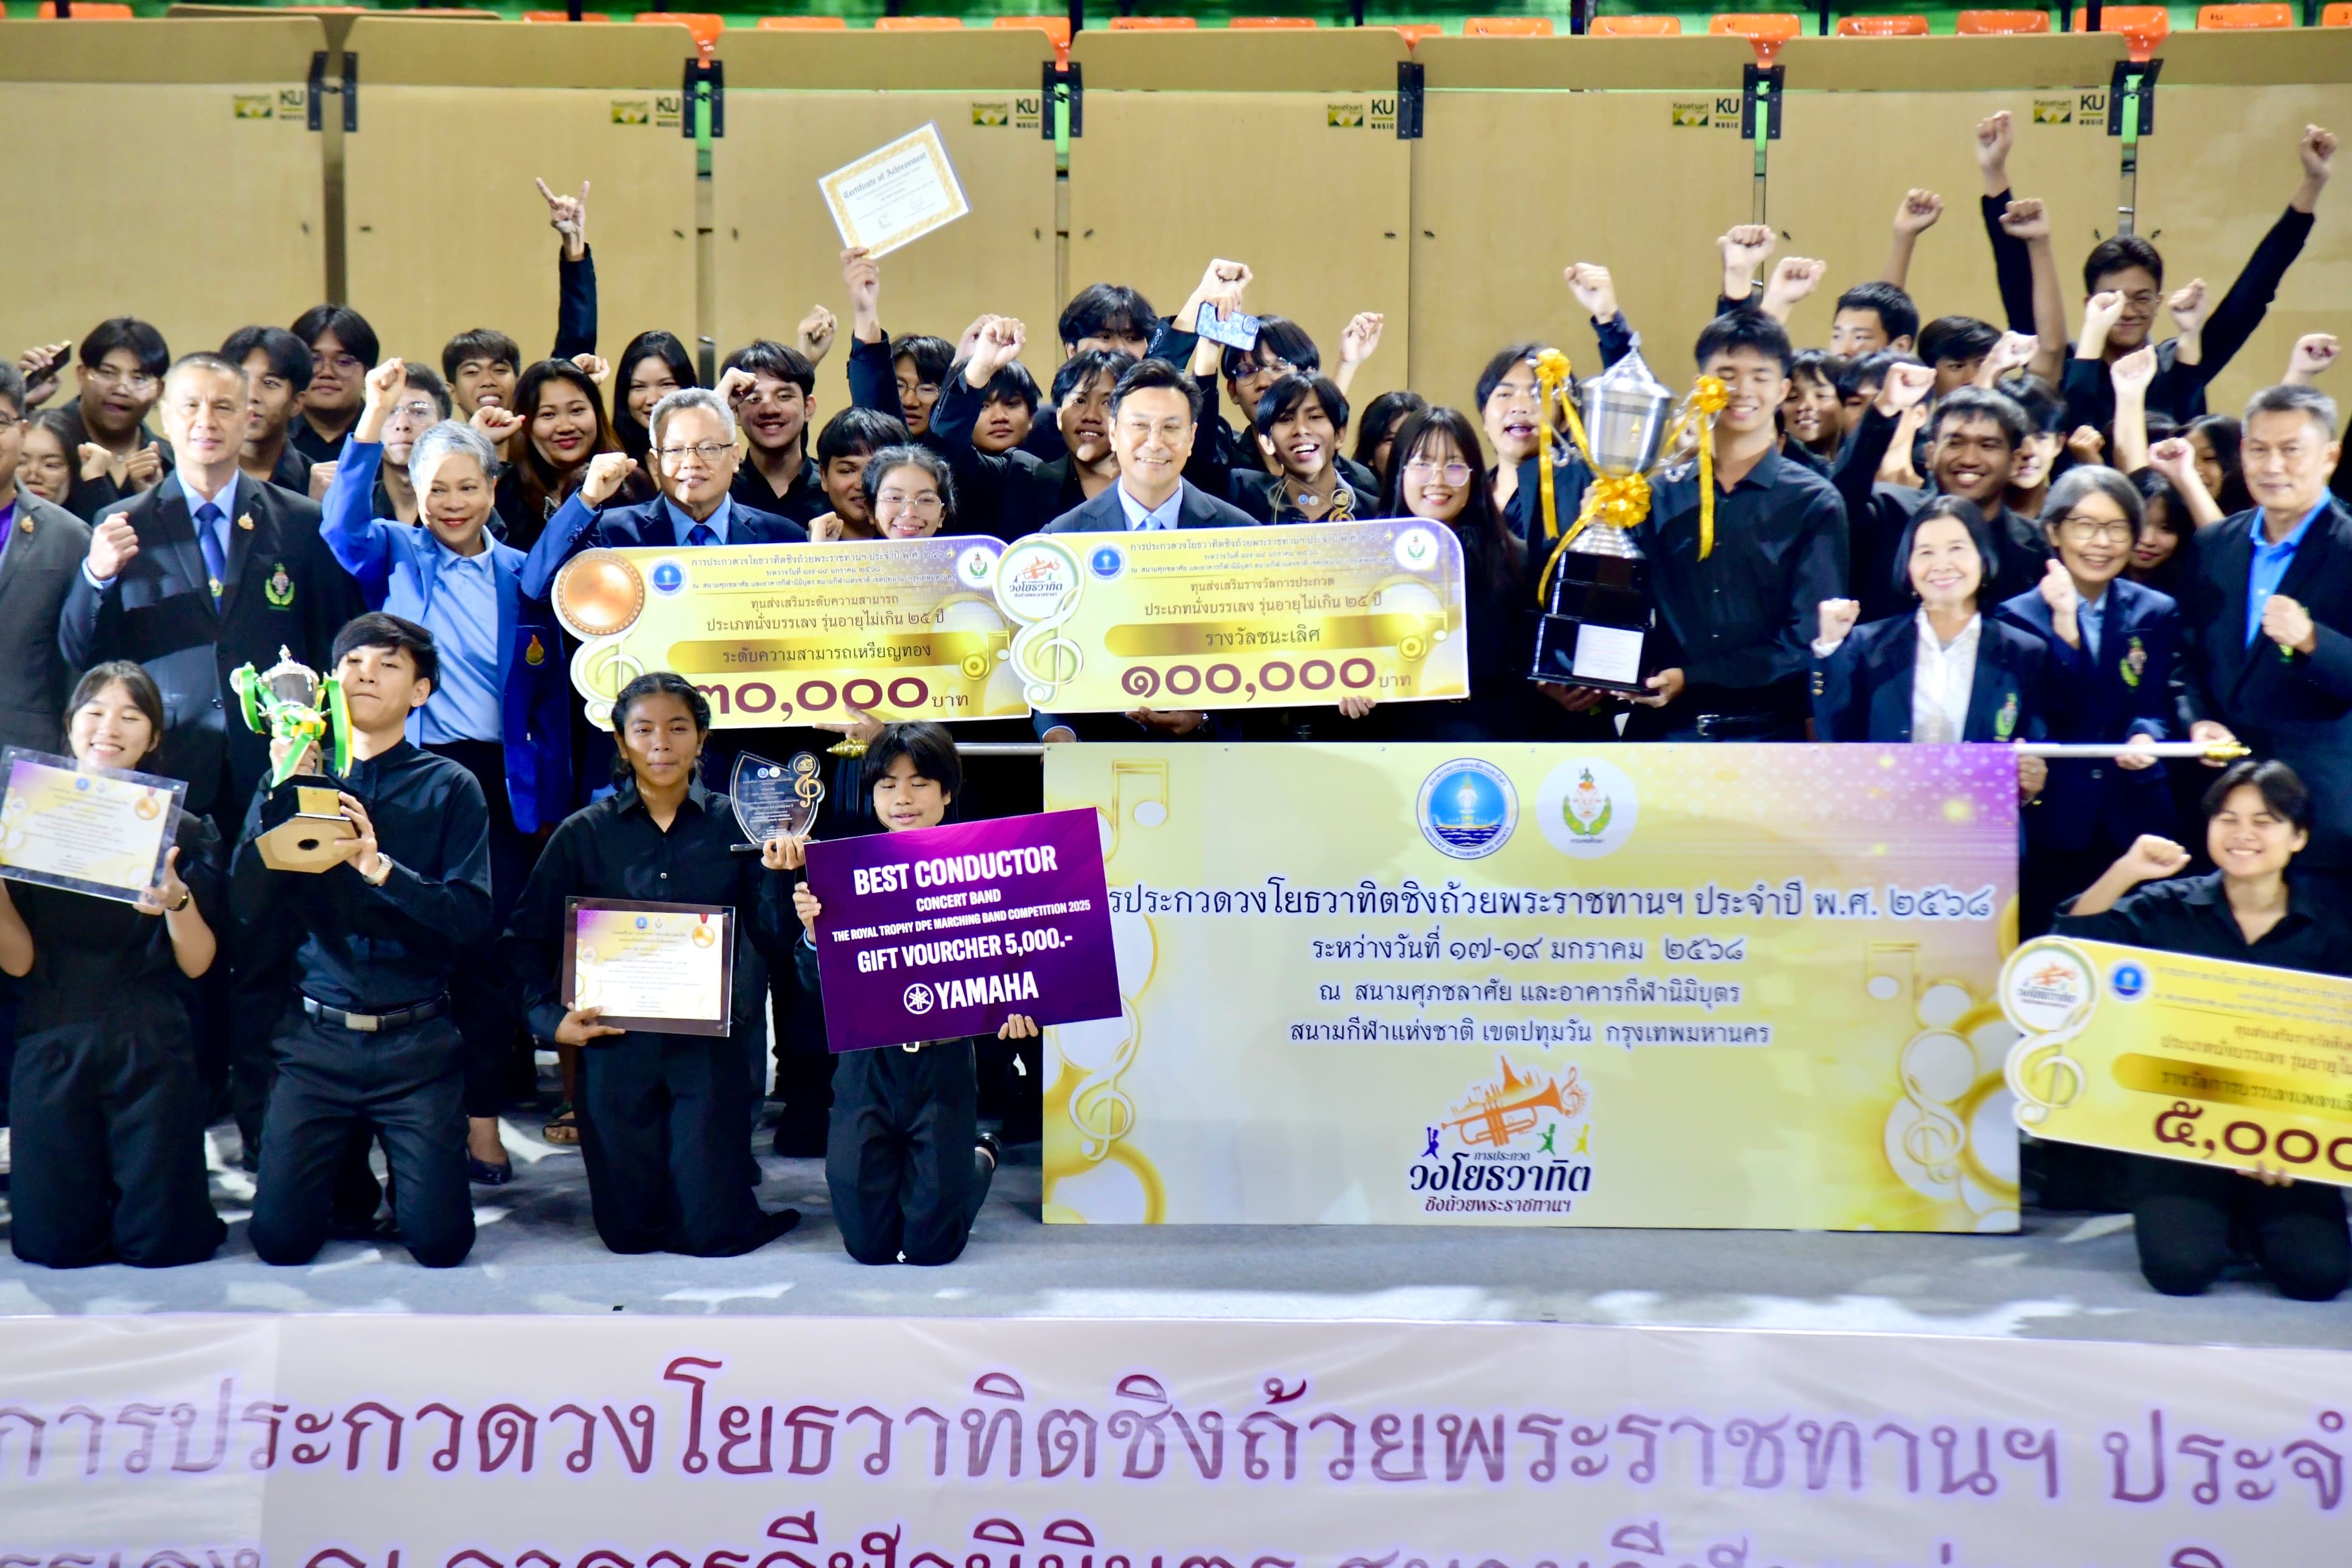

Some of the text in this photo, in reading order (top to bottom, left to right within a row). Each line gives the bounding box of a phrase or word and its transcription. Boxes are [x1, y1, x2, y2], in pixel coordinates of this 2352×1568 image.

[657, 97, 680, 112] KU
[1016, 99, 1039, 114] KU
[1372, 99, 1394, 115] KU
[1716, 98, 1740, 114] KU
[2081, 94, 2105, 110] KU
[843, 177, 877, 199] Certificate
[877, 172, 885, 182] of
[886, 152, 927, 177] Achievement
[1191, 576, 1335, 595] ทุนส่งเสริมรางวัลการประกวด
[751, 594, 899, 612] ทุนส่งเสริมระดับความสามารถ
[1145, 591, 1382, 618] ประเภทนั่งบรรเลง รุ่นอายุไม่เกิน ๒๕ ปี
[707, 608, 945, 632] ประเภทนั่งบรรเลง รุ่นอายุไม่เกิน ๒๕ ปี
[1206, 623, 1320, 647] รางวัลชนะเลิศ
[723, 642, 931, 664] ระดับความสามารถเหรียญทอง
[1121, 657, 1411, 703] ๑๐๐,๐๐๐ บาท
[932, 693, 968, 708] บาท
[853, 845, 1058, 896] BEST CONDUCTOR
[916, 888, 1001, 911] CONCERT BAND
[1695, 880, 1802, 916] ประจำปี
[1815, 888, 1878, 916] พ.ศ.
[1889, 887, 1993, 916] ๒๕๖๘
[832, 900, 1091, 943] THE ROYAL TROPHY DPE MARCHING BAND COMPETITION 2025
[857, 927, 1073, 973] GIFT VOURCHER 5,000.-
[1313, 925, 1744, 961] ระหว่างวันที่ ๑๗-๑๙ มกราคม ๒๕๖๘
[934, 971, 1039, 1010] YAMAHA
[1319, 978, 1740, 1009] ณ สนามศุภชลาศัย และอาคารกีฬานิมิบุตร
[1291, 1016, 1770, 1049] สนามกีฬาแห่งชาติ เขตปทุมวัน กรุงเทพมหานคร
[1474, 1151, 1531, 1162] การประกวด
[1409, 1152, 1591, 1192] วงโยธวาทิต
[1425, 1195, 1571, 1213] ชิงถ้วยพระราชทานฯ
[0, 1357, 2059, 1499] การประกวดวงโยธวาทิตชิงถ้วยพระราชทานฯ
